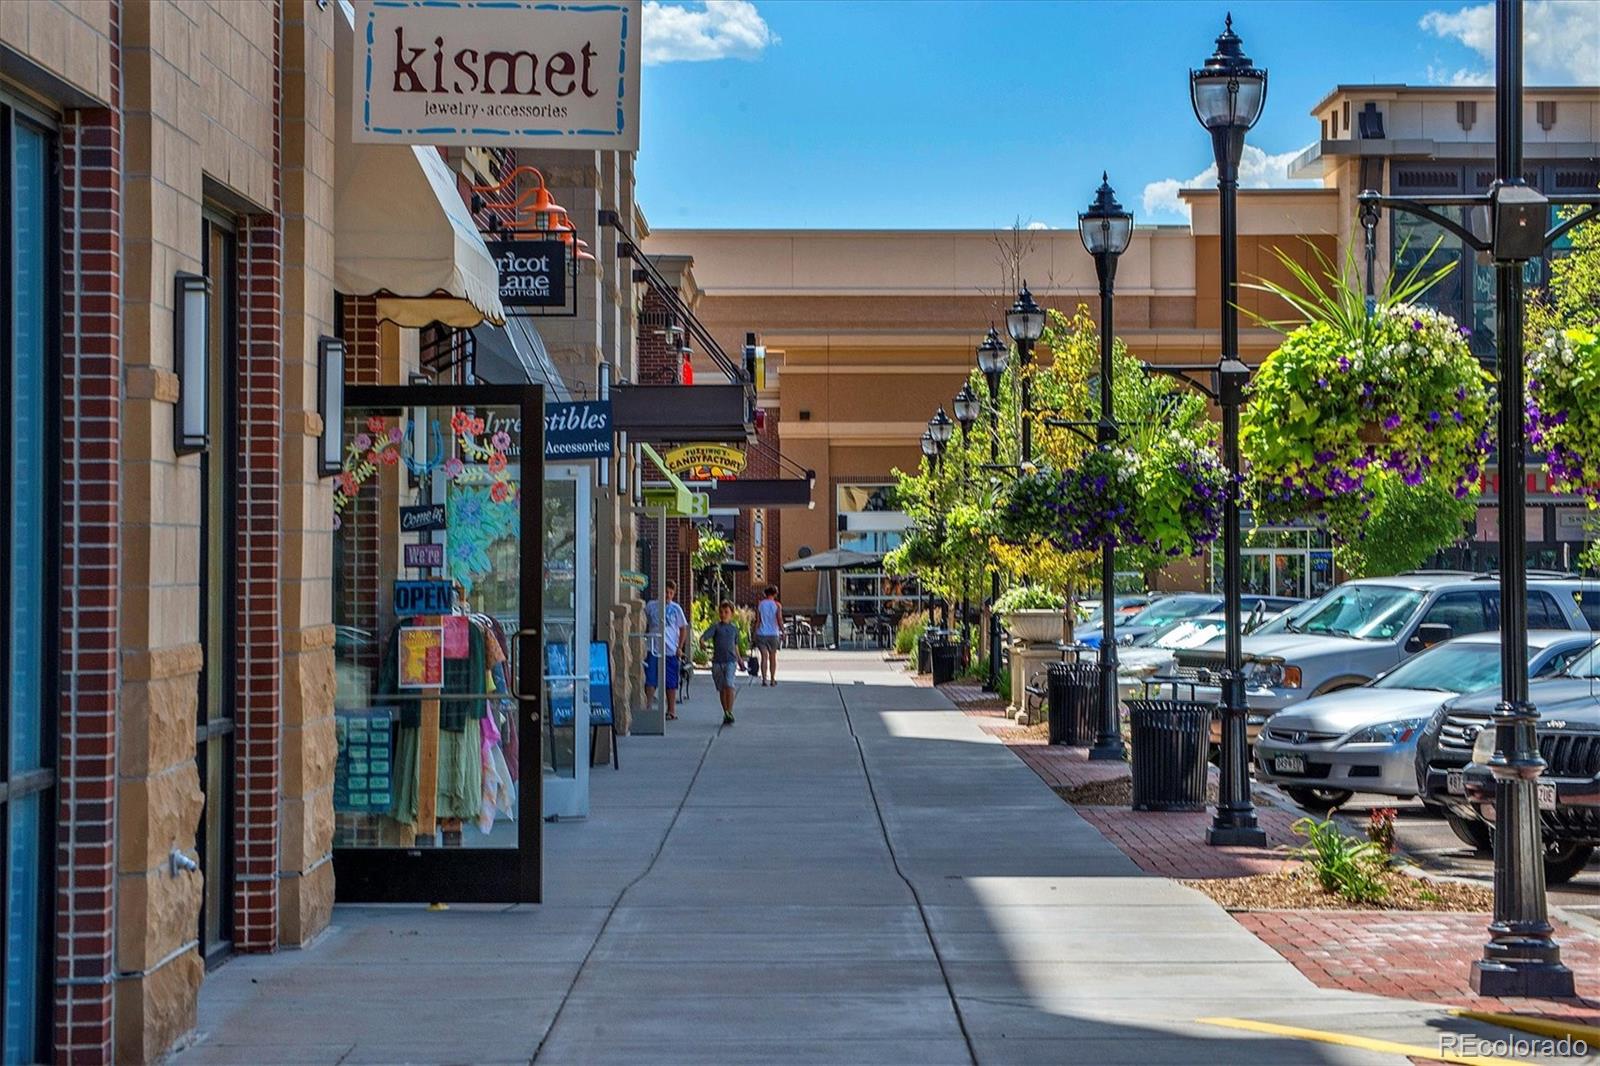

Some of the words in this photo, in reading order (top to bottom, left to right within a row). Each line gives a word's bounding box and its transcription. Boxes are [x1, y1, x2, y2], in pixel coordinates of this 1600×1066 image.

[393, 26, 599, 98] kismet
[487, 102, 568, 118] accessories
[496, 252, 550, 272] ricot
[499, 289, 550, 297] OUTIQUE
[545, 439, 610, 455] Accessories
[669, 455, 702, 470] CANDY
[403, 510, 432, 528] Come
[408, 546, 441, 564] We're
[396, 586, 451, 609] OPEN
